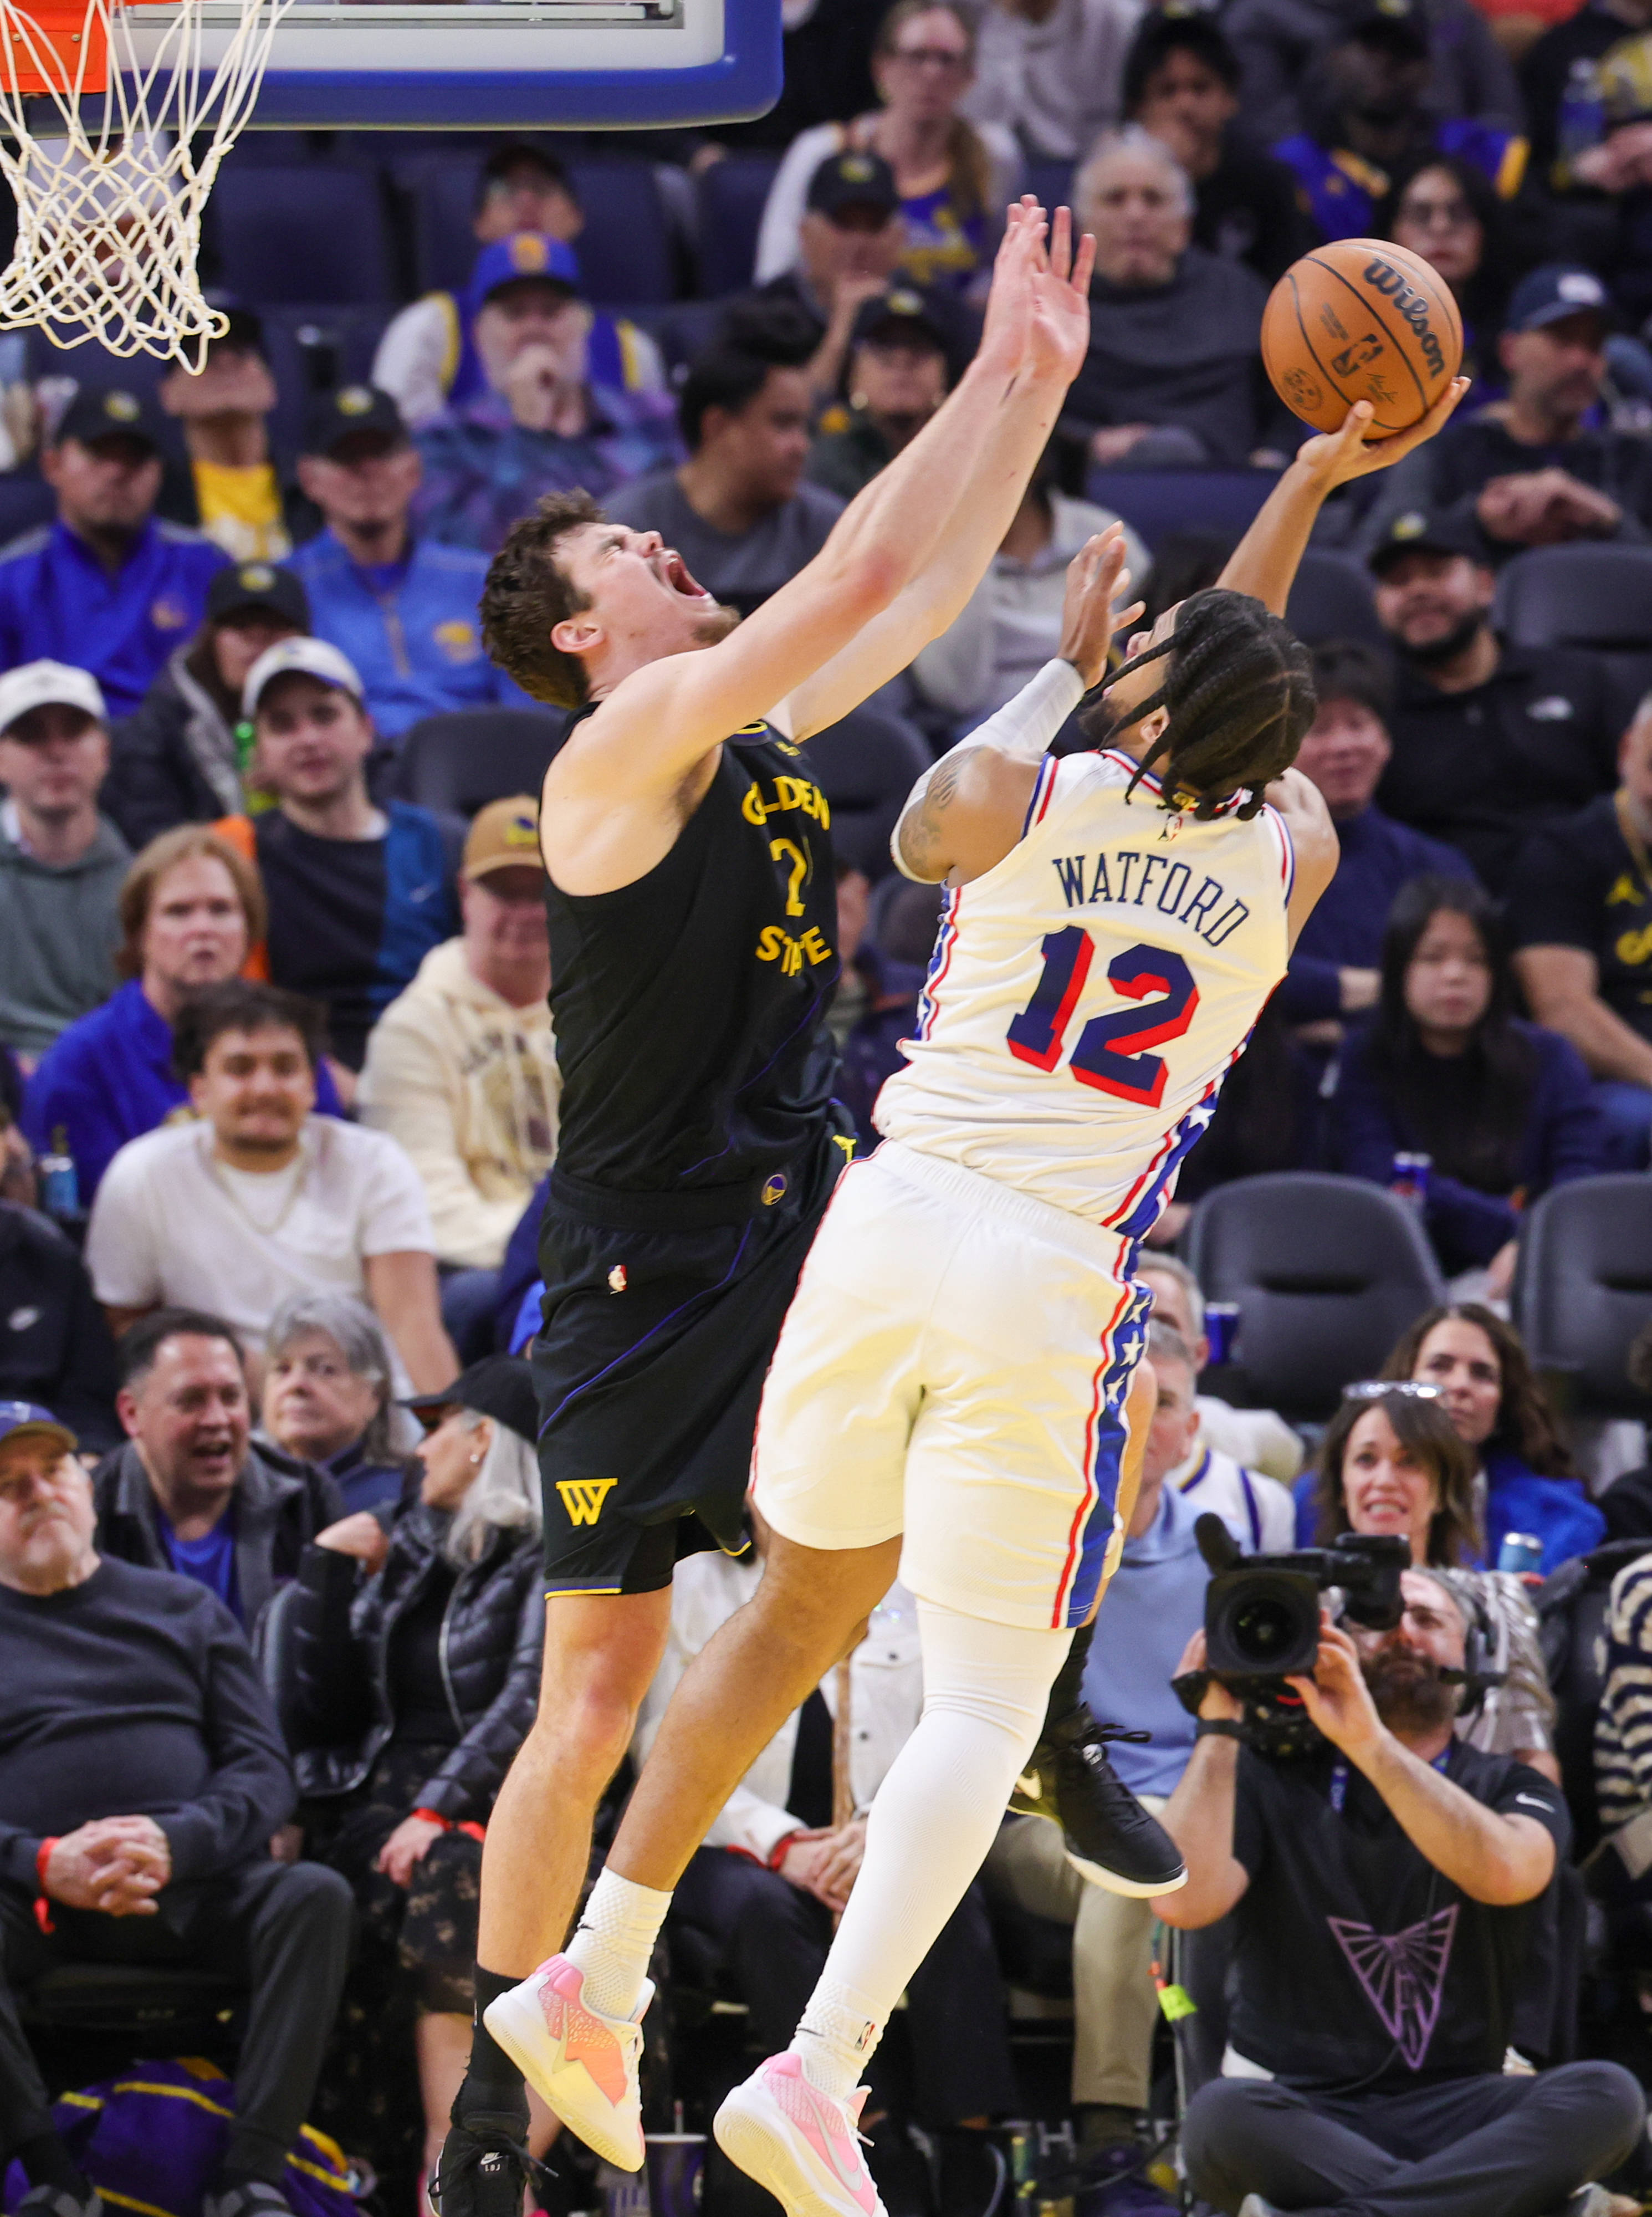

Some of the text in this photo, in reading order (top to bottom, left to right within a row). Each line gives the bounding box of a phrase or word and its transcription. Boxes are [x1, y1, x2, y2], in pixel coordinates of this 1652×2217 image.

[1363, 257, 1445, 379] Wilson
[1052, 851, 1250, 947] WATFORD
[1006, 925, 1200, 1108] 12
